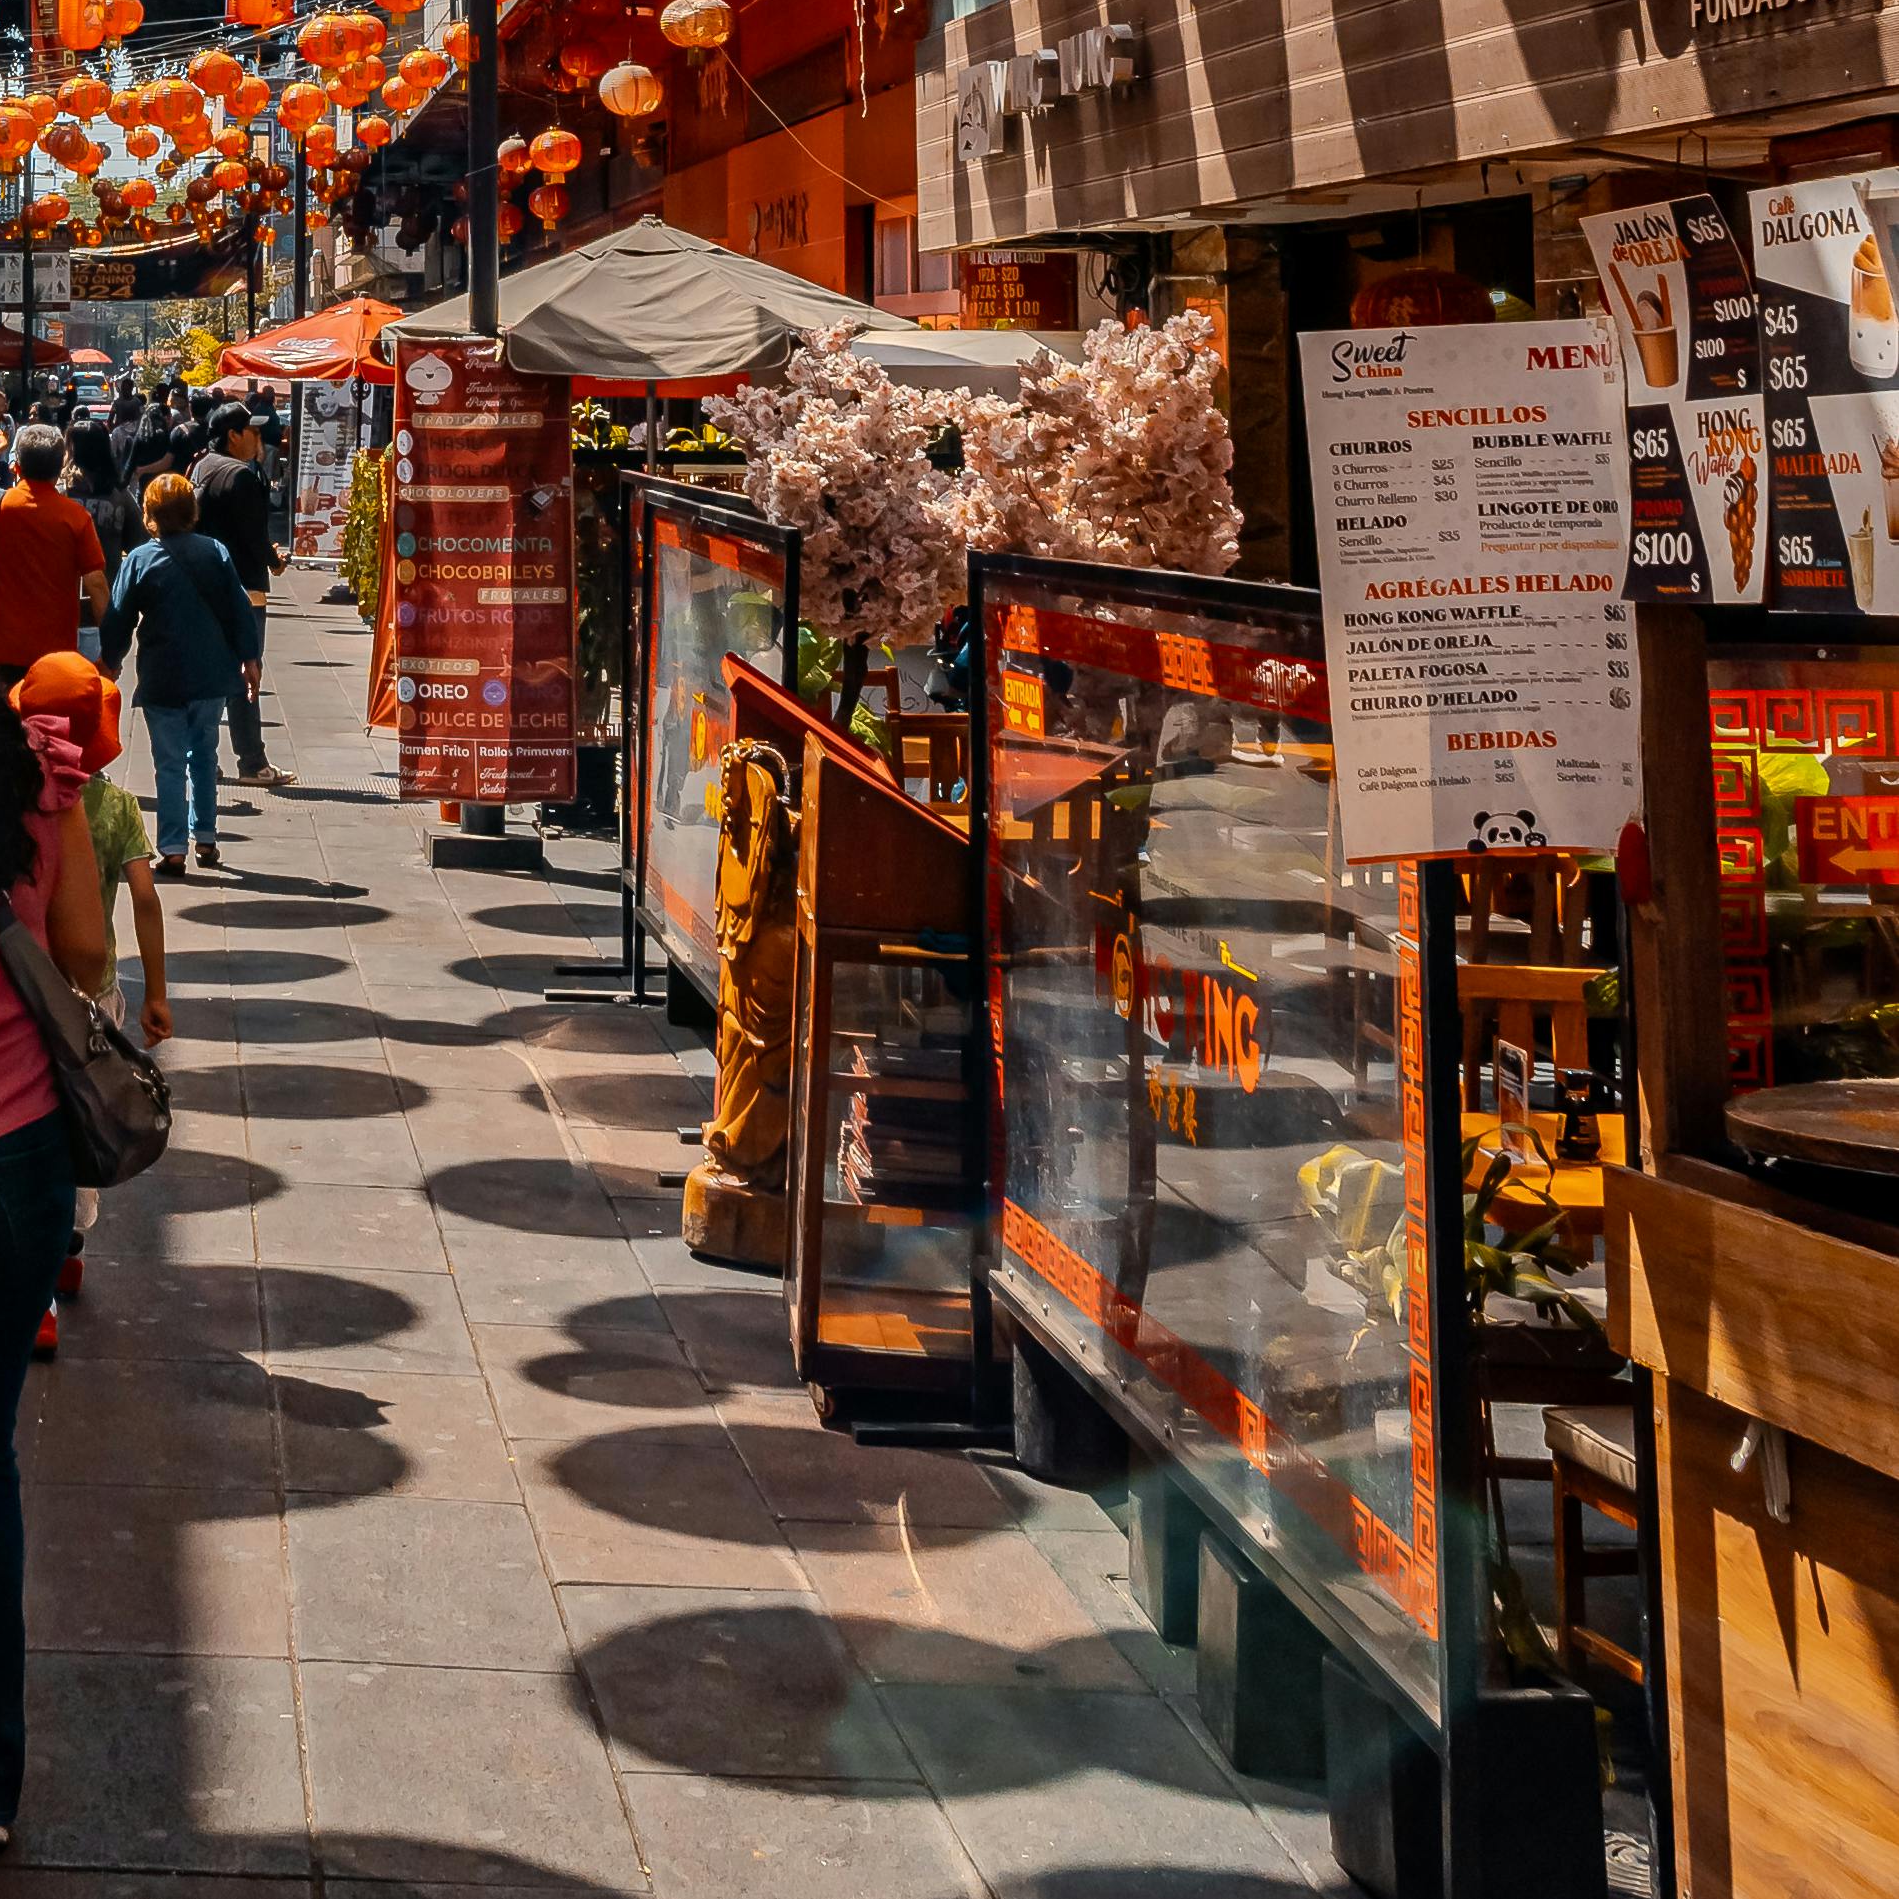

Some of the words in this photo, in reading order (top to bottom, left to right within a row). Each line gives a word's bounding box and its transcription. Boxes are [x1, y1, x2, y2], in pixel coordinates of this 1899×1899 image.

[1768, 196, 1795, 217] Café
[1612, 211, 1674, 245] JALÓN
[1687, 213, 1725, 244] $65
[1762, 206, 1860, 247] DALGONA
[1612, 243, 1630, 262] de
[1630, 235, 1693, 268] OREJA
[93, 275, 136, 285] CHINO
[1713, 296, 1752, 323] $100
[1764, 304, 1799, 336] $45
[1331, 331, 1418, 382] Sweet
[1695, 337, 1726, 359] $100
[1355, 364, 1403, 378] China
[1769, 355, 1808, 391] $65
[417, 414, 539, 426] TRADICIONALES
[1407, 405, 1547, 428] SENCILLOS
[1696, 407, 1752, 439] HONG
[1472, 433, 1549, 449] BUBBLE
[1551, 431, 1612, 446] WAFFLE
[1706, 426, 1762, 458] KONG
[1771, 417, 1807, 450] $65
[1329, 439, 1412, 456] CHURROS
[1633, 428, 1670, 461] $65
[1332, 464, 1340, 475] 3
[1342, 463, 1389, 475] Churros
[1431, 458, 1455, 471] $25
[1474, 455, 1523, 468] Sencillo
[1687, 445, 1736, 486] Waffle
[1774, 453, 1863, 476] MALTEADA
[1333, 480, 1341, 491] 6
[1343, 478, 1389, 491] Churros
[1433, 475, 1455, 486] $45
[400, 488, 504, 500] CHOCOLOVERS
[1335, 495, 1375, 507] Churro
[1377, 492, 1418, 505] Relleno
[1434, 490, 1458, 502] $30
[1477, 501, 1563, 517] LINGOTE
[1565, 501, 1591, 514] DE
[1592, 499, 1619, 514] ORO
[1336, 514, 1407, 531] HELADO
[1479, 520, 1531, 531] Producto
[1532, 519, 1546, 530] de
[1548, 518, 1603, 530] temporada
[417, 537, 553, 552] CHOCOMENTA
[1338, 534, 1382, 547] Sencillo
[1438, 530, 1461, 543] $35
[1480, 541, 1536, 554] Preguntar
[1539, 542, 1559, 553] por
[1632, 531, 1694, 567] $100
[1778, 534, 1815, 567] $65
[418, 564, 555, 580] CHOCOBAILEYS
[481, 590, 561, 601] FRUTALES
[1365, 576, 1510, 601] AGRÉGALES
[1515, 573, 1614, 594] HELADO
[419, 608, 486, 624] FRUTOS
[490, 609, 552, 624] ROJOS
[1343, 611, 1394, 627] HONG
[1397, 608, 1447, 623] KONG
[1448, 604, 1522, 621] WAFFLE
[1604, 604, 1627, 622] $65
[1346, 636, 1404, 655] JALÓN
[1406, 637, 1432, 652] DE
[1433, 633, 1494, 650] OREJA
[1605, 632, 1628, 651] $65
[401, 659, 473, 672] EXOTICOS
[1348, 666, 1416, 683] PALETA
[1419, 661, 1489, 679] FOGOSA
[1607, 659, 1630, 679] $35
[418, 683, 469, 699] OREO
[1004, 677, 1041, 710] ENTRADA
[1350, 694, 1423, 712] CHURRO
[1426, 689, 1518, 708] D'HELADO
[419, 712, 477, 727] DULCE
[480, 712, 505, 728] DE
[509, 712, 569, 728] LECHE
[398, 743, 441, 756] Ramen
[442, 743, 470, 757] Frito
[1446, 730, 1558, 752] BEBIDAS
[479, 745, 513, 757] Rollos
[1357, 768, 1378, 778] Café
[1380, 766, 1418, 778] Dalgona
[1494, 759, 1514, 770] $45
[1556, 758, 1601, 770] Malteada
[1359, 781, 1379, 792] Café
[1381, 780, 1419, 792] Dalgona
[1420, 779, 1438, 788] con
[1438, 775, 1472, 787] Helado
[1495, 773, 1516, 783] $65
[1557, 772, 1597, 783] Sorbete
